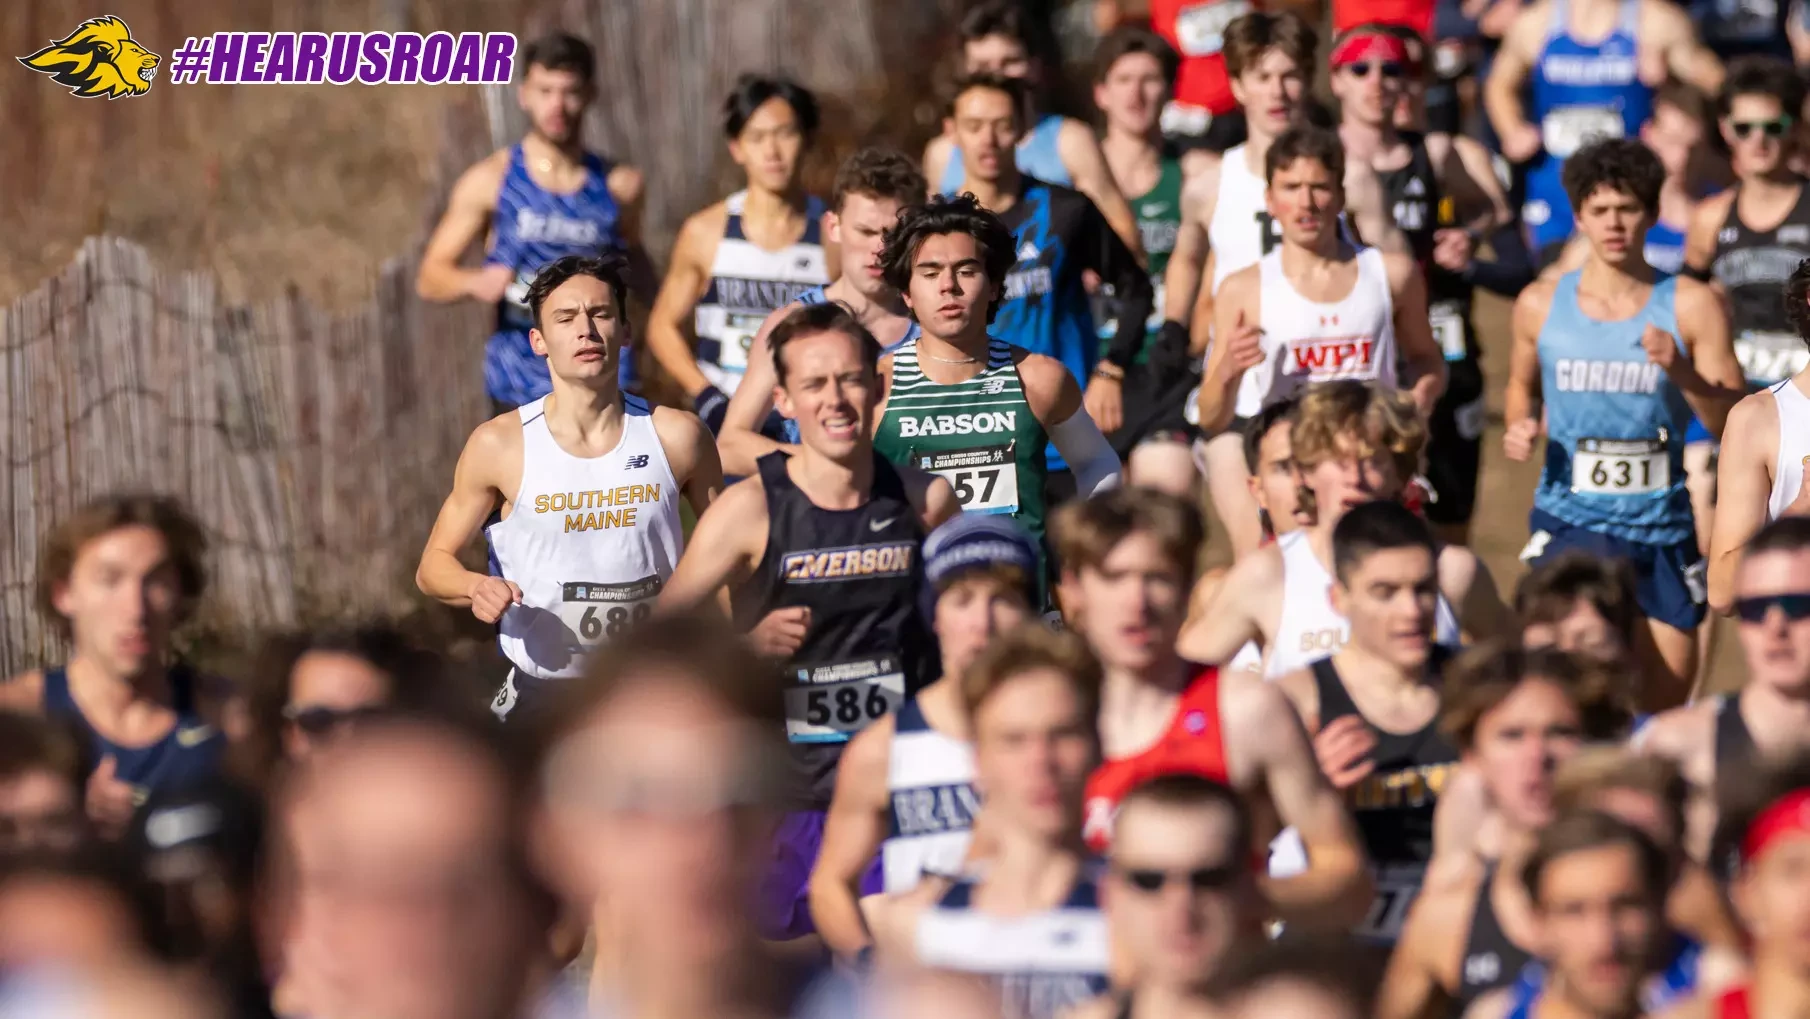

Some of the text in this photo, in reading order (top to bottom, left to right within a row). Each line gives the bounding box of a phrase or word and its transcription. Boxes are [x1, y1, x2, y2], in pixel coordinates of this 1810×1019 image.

[1294, 341, 1371, 368] WPI
[1556, 359, 1659, 394] GORDON
[898, 410, 1017, 437] BABSON
[934, 455, 992, 468] CHAMPIONSHIPS
[1591, 460, 1651, 486] 631
[534, 483, 661, 514] SOUTHERN
[564, 507, 638, 534] MAINE
[785, 545, 912, 579] EMERSON
[807, 684, 888, 726] 586
